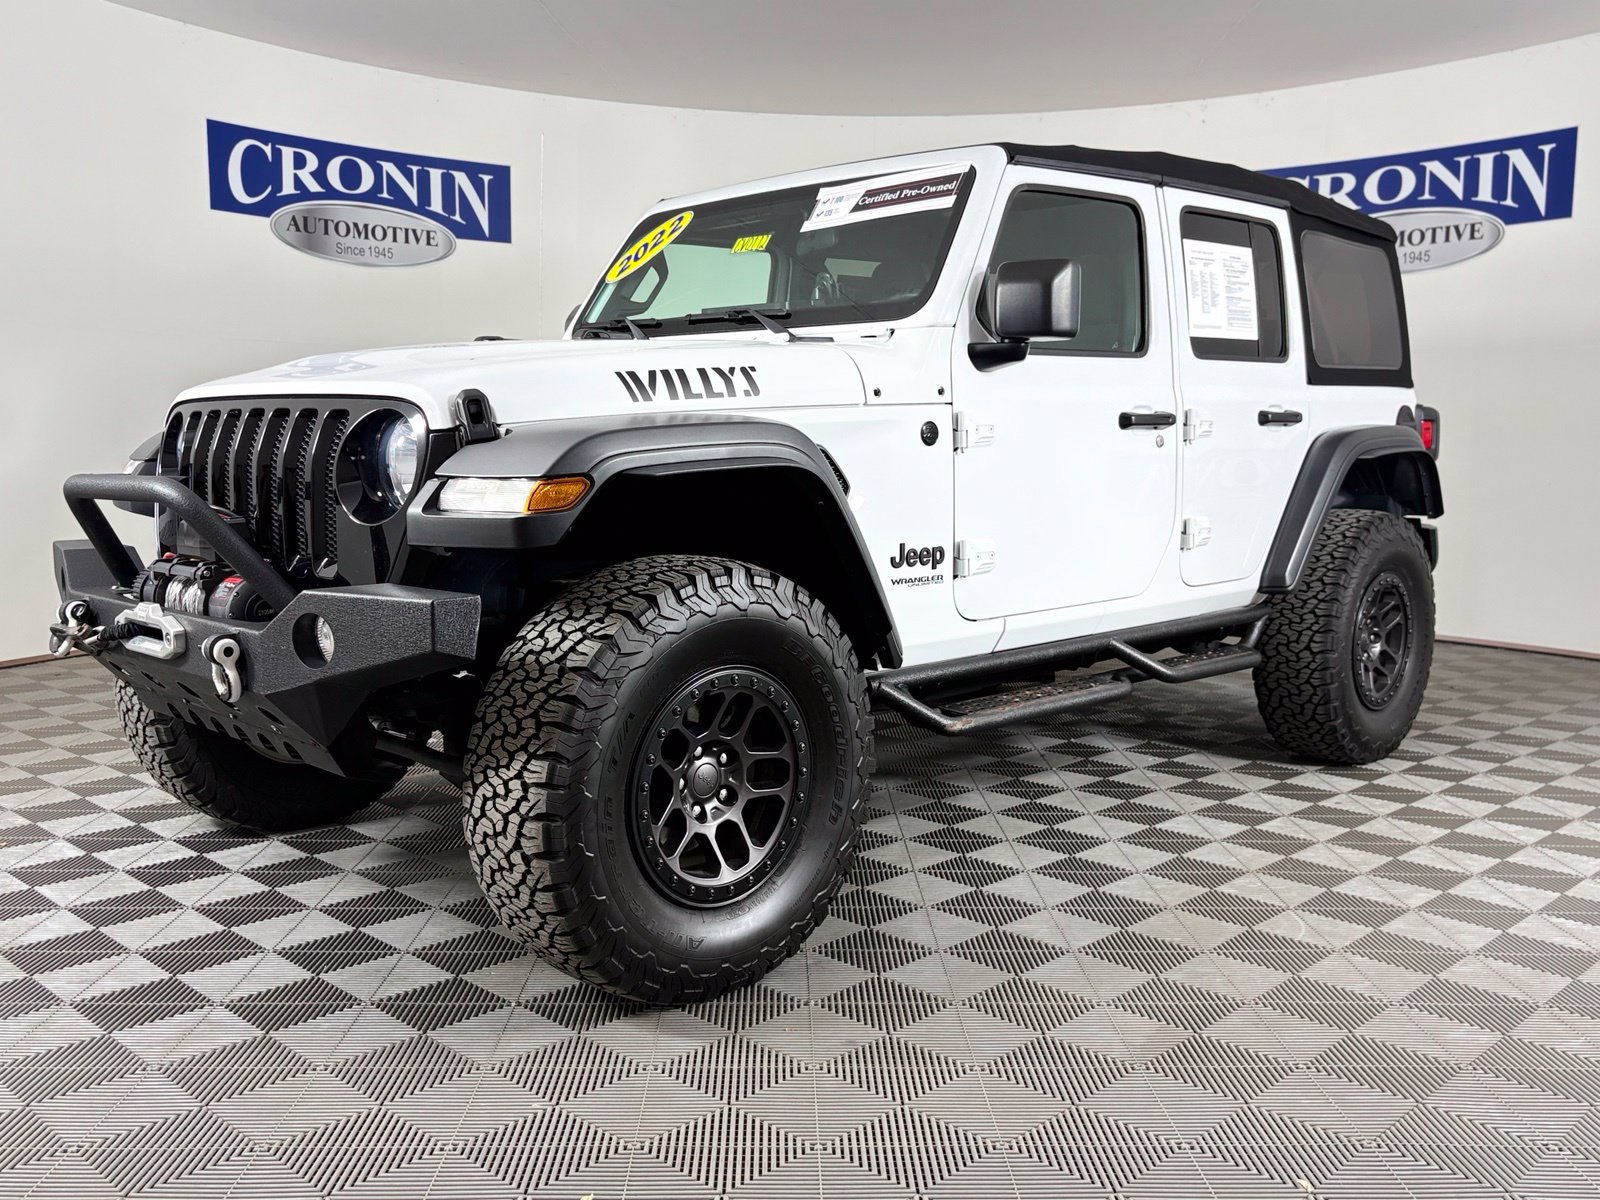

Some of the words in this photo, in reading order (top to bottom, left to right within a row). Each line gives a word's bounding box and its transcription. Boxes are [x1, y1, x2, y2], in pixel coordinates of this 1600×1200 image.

[227, 138, 493, 238] CRONIN
[858, 193, 899, 205] Certified
[902, 181, 956, 198] Pre-Owned
[286, 214, 439, 247] AUTOMOTIVE
[335, 242, 366, 257] Since
[367, 245, 395, 260] 1945
[616, 215, 684, 278] 2022
[1402, 250, 1431, 264] 1945
[614, 366, 761, 403] WILLYS
[890, 542, 945, 570] Jeep
